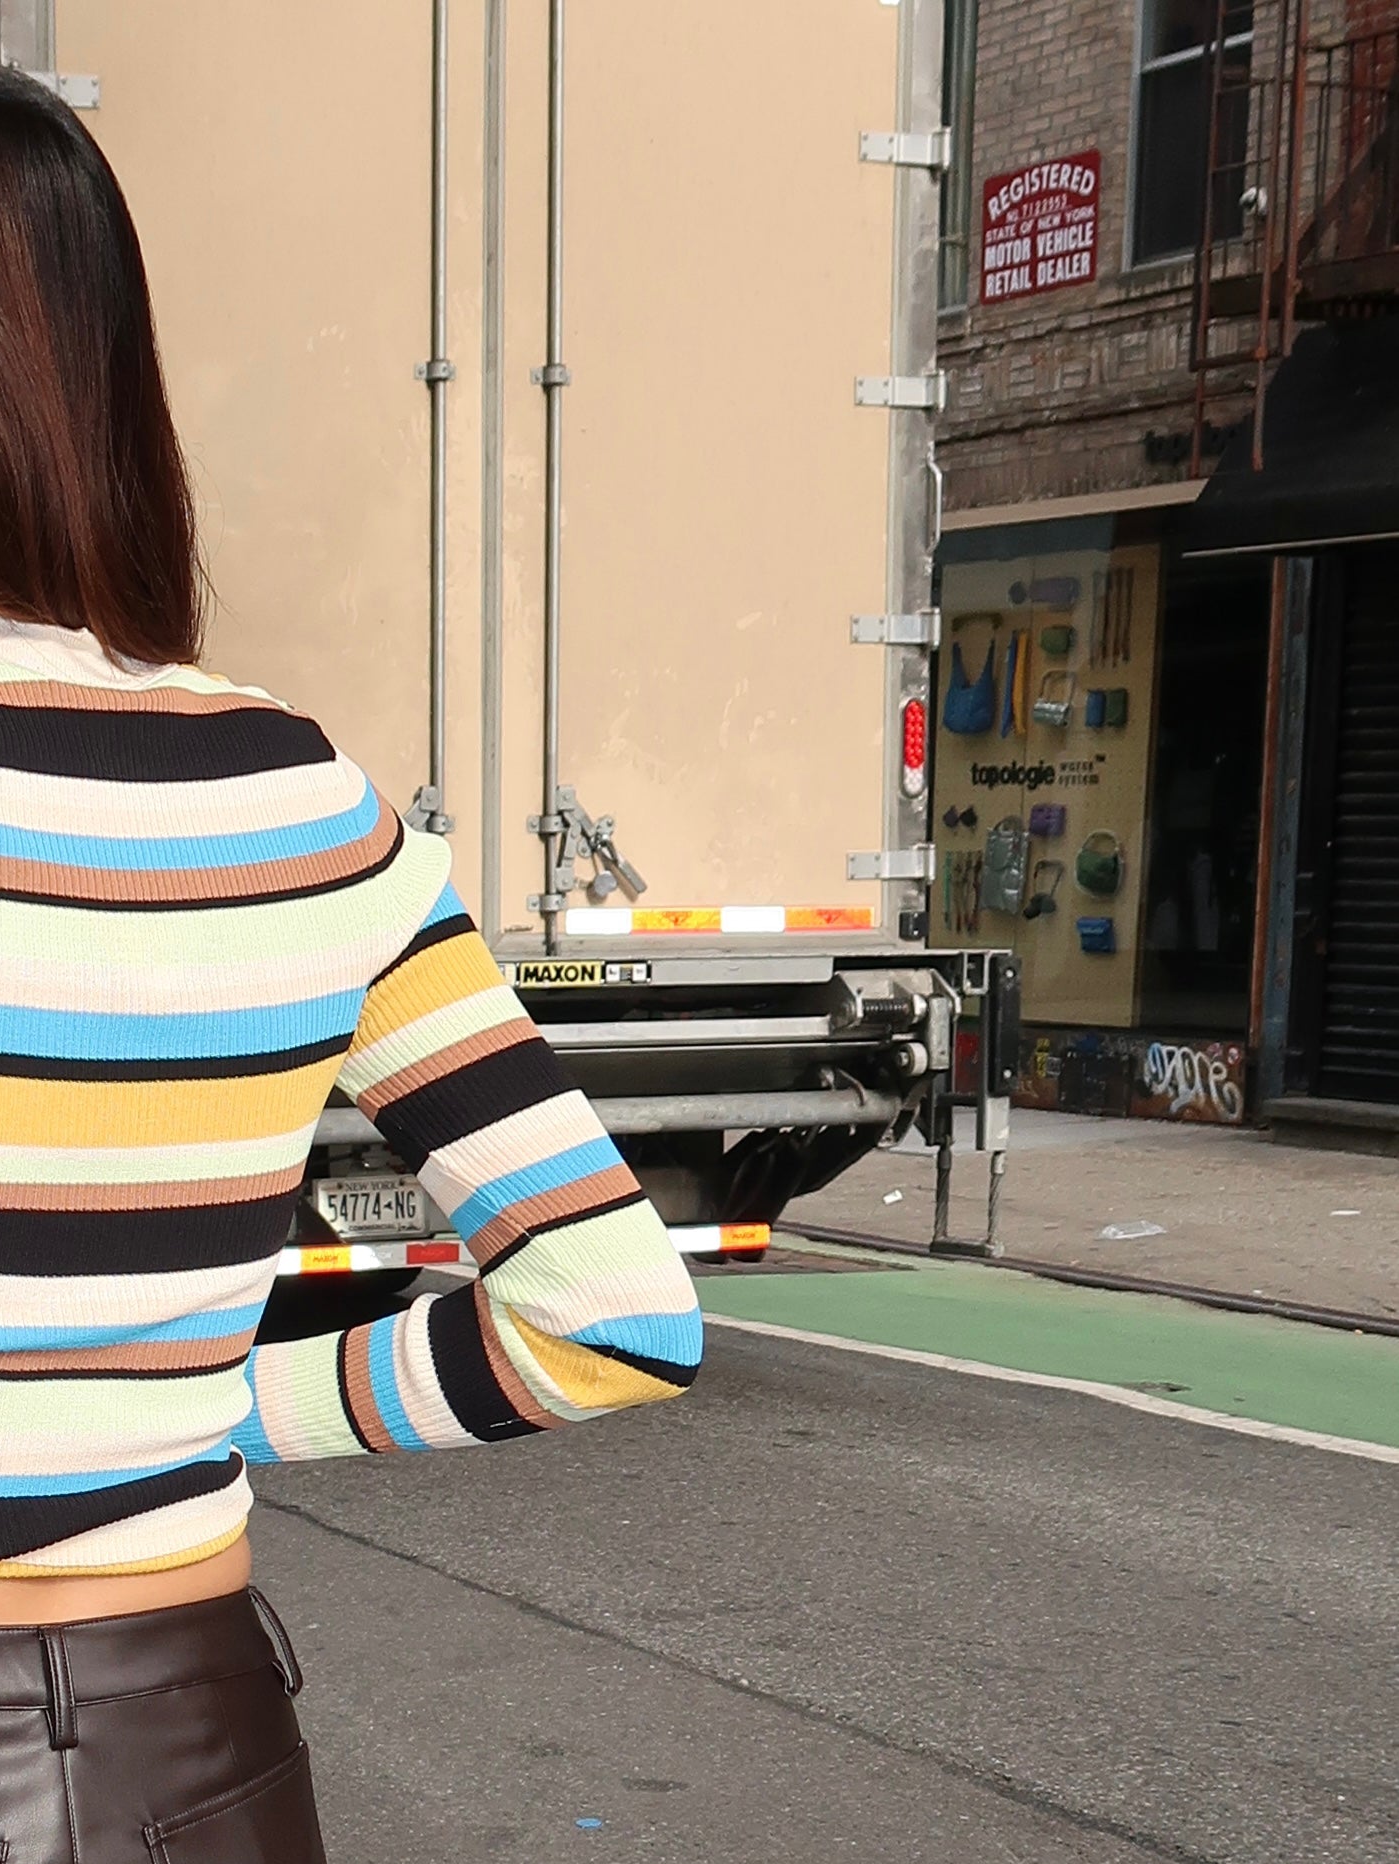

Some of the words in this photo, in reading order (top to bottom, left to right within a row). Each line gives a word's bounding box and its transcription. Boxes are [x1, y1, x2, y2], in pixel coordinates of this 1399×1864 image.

[988, 164, 1094, 220] REGISTERED
[986, 225, 1015, 242] STATE
[1020, 220, 1034, 234] OF
[1037, 214, 1060, 230] NEW
[1066, 205, 1094, 222] YORK
[985, 238, 1030, 270] MOTOR
[1037, 222, 1093, 257] VEHICLE
[986, 266, 1031, 297] RETAIL
[1037, 252, 1090, 287] DEALER
[972, 761, 1054, 790] topologie
[524, 965, 595, 982] MAXON
[346, 1182, 367, 1192] NEW
[370, 1181, 398, 1191] YORK
